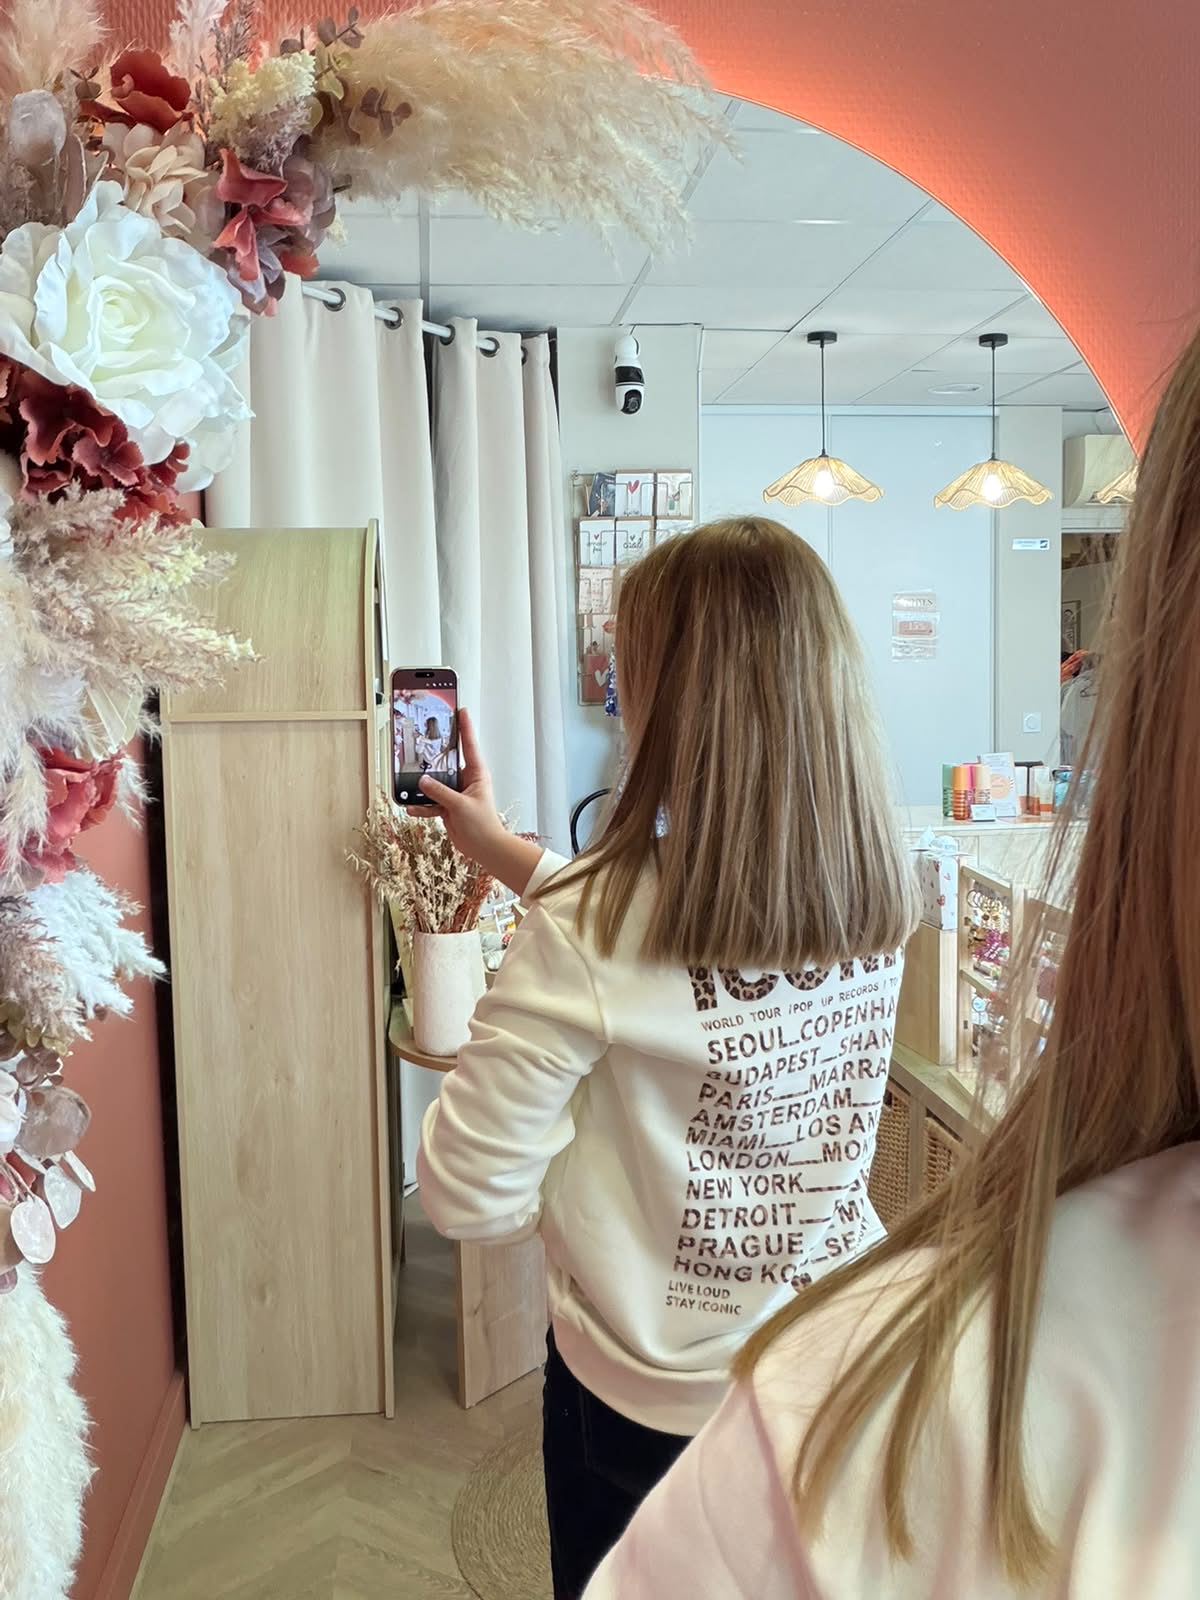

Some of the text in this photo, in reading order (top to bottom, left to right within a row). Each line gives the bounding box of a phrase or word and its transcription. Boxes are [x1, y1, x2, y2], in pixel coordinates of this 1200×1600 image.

[701, 1015, 744, 1031] WORLD
[750, 1007, 781, 1023] TOUR
[821, 996, 834, 1007] UP
[839, 982, 880, 1002] RECORDS
[686, 1177, 732, 1200] NEW
[673, 1256, 752, 1282] HONG
[668, 1280, 730, 1298] LIVE LOUD
[666, 1296, 742, 1315] STAY ICONIC
